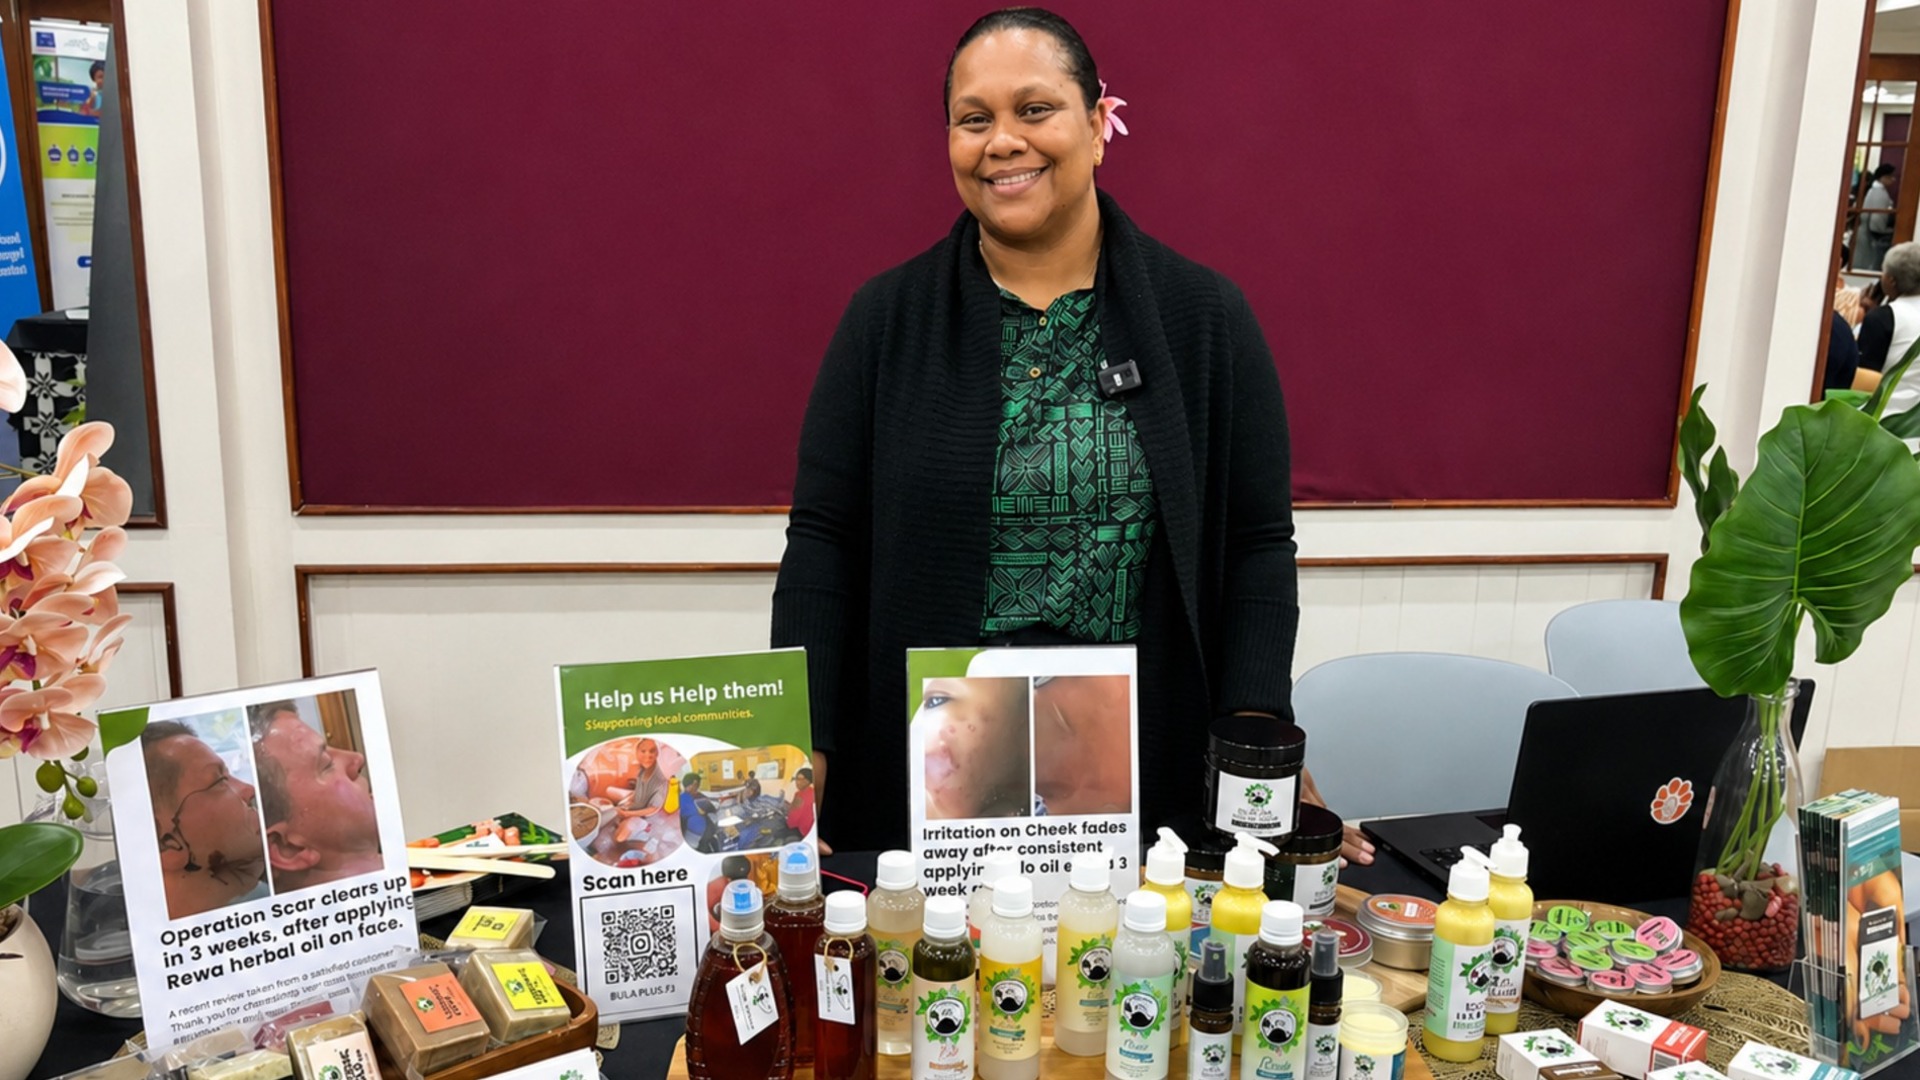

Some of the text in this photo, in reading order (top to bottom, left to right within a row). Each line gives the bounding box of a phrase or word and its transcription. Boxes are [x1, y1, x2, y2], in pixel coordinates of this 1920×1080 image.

[584, 679, 784, 712] Help us Help them!
[654, 712, 681, 725] local
[923, 821, 1127, 841] Irritation on Cheek fades
[923, 847, 969, 862] away
[1017, 840, 1103, 856] consistent
[1039, 859, 1059, 873] oil
[1119, 856, 1128, 869] 3
[582, 868, 688, 892] Scan here
[923, 882, 968, 897] week
[160, 875, 408, 947] Operation Scar clears up
[163, 950, 184, 969] in
[190, 945, 203, 961] 3
[207, 928, 278, 956] weeks,
[282, 914, 330, 938] after
[166, 918, 403, 990] Rewa herbal oil on face.
[169, 1010, 177, 1019] A
[178, 1000, 211, 1016] recent
[212, 992, 245, 1006] review
[246, 983, 275, 997] taken
[276, 975, 300, 988] from
[170, 1015, 204, 1032] Thank
[207, 1010, 226, 1024] you
[227, 1005, 240, 1016] for
